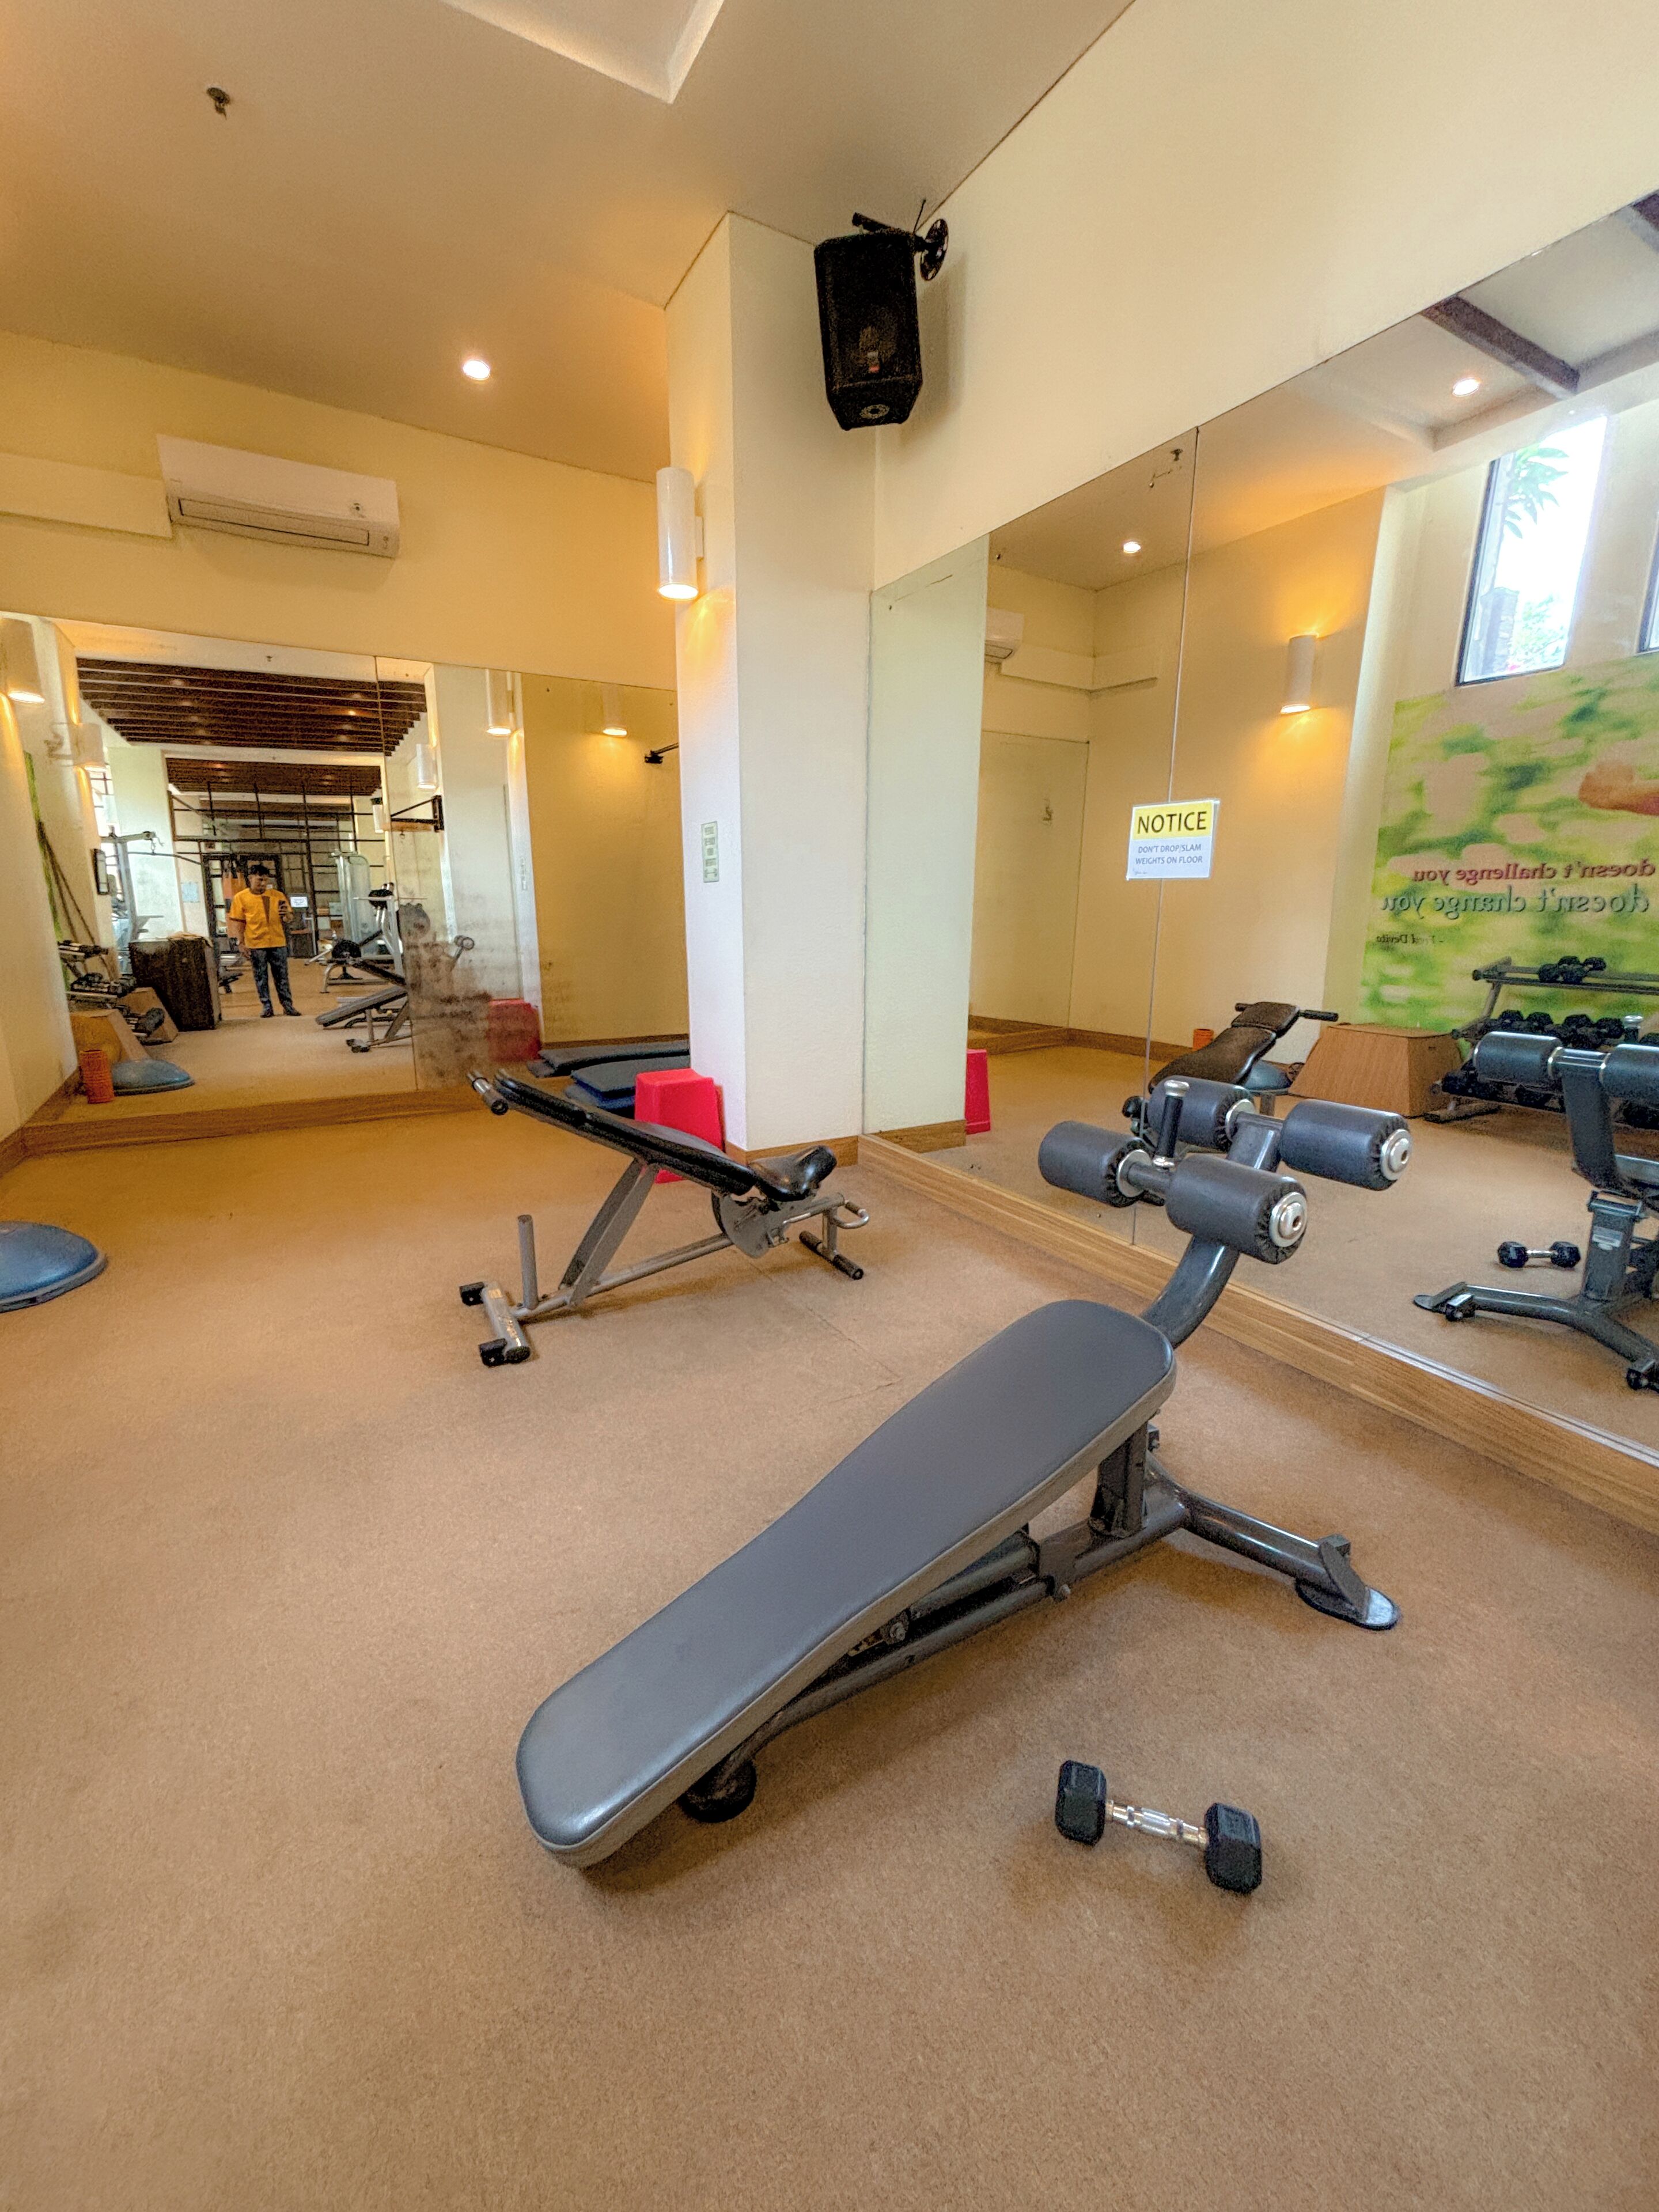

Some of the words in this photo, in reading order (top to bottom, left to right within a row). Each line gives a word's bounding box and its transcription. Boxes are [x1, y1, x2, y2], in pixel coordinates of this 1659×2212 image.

[1137, 811, 1207, 834] NOTICE
[1138, 845, 1159, 854] DON'T
[1135, 857, 1165, 865] WEIGHTS
[1179, 855, 1203, 863] FLOOR
